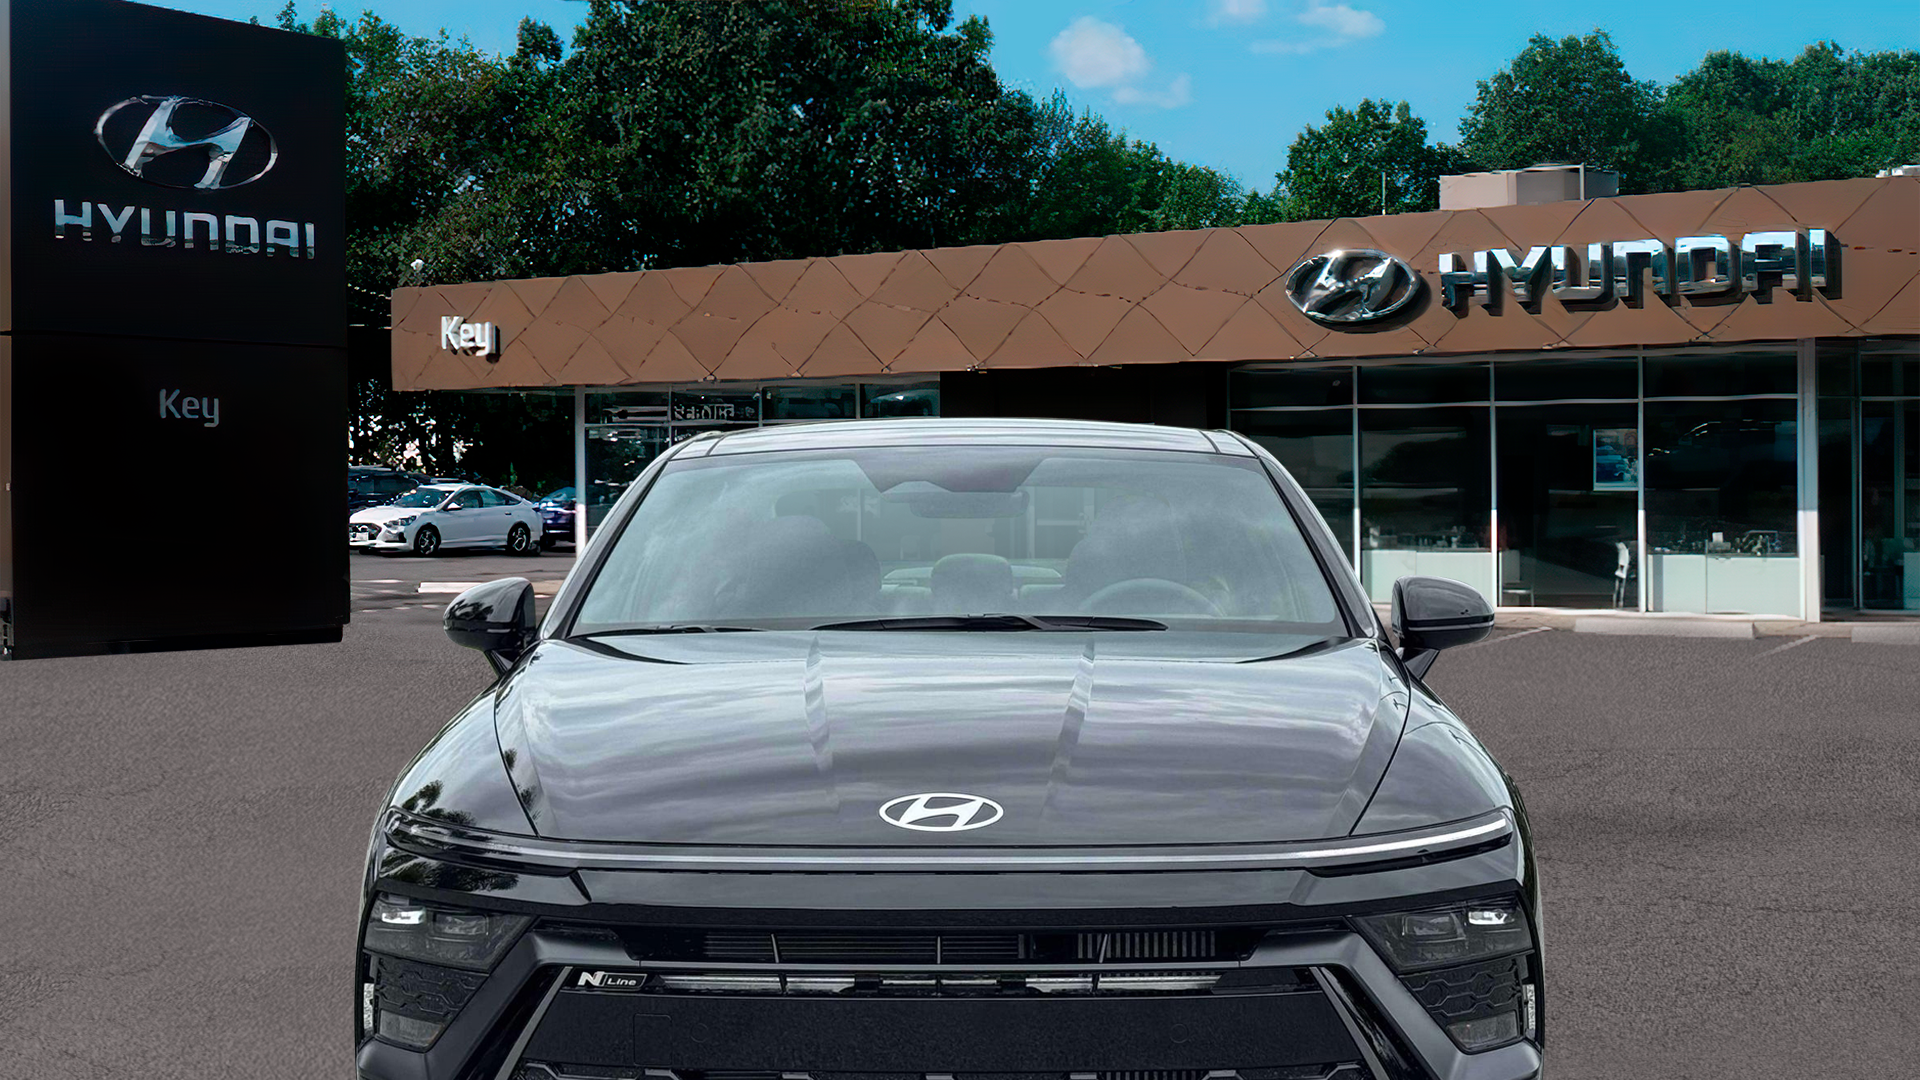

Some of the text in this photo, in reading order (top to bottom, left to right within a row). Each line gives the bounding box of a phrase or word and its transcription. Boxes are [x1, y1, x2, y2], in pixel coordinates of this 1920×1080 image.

[54, 199, 315, 260] HYUNDAI
[1438, 228, 1842, 318] HYUNDAI
[441, 315, 493, 357] Key
[159, 388, 220, 428] Key
[577, 971, 637, 986] N Line
